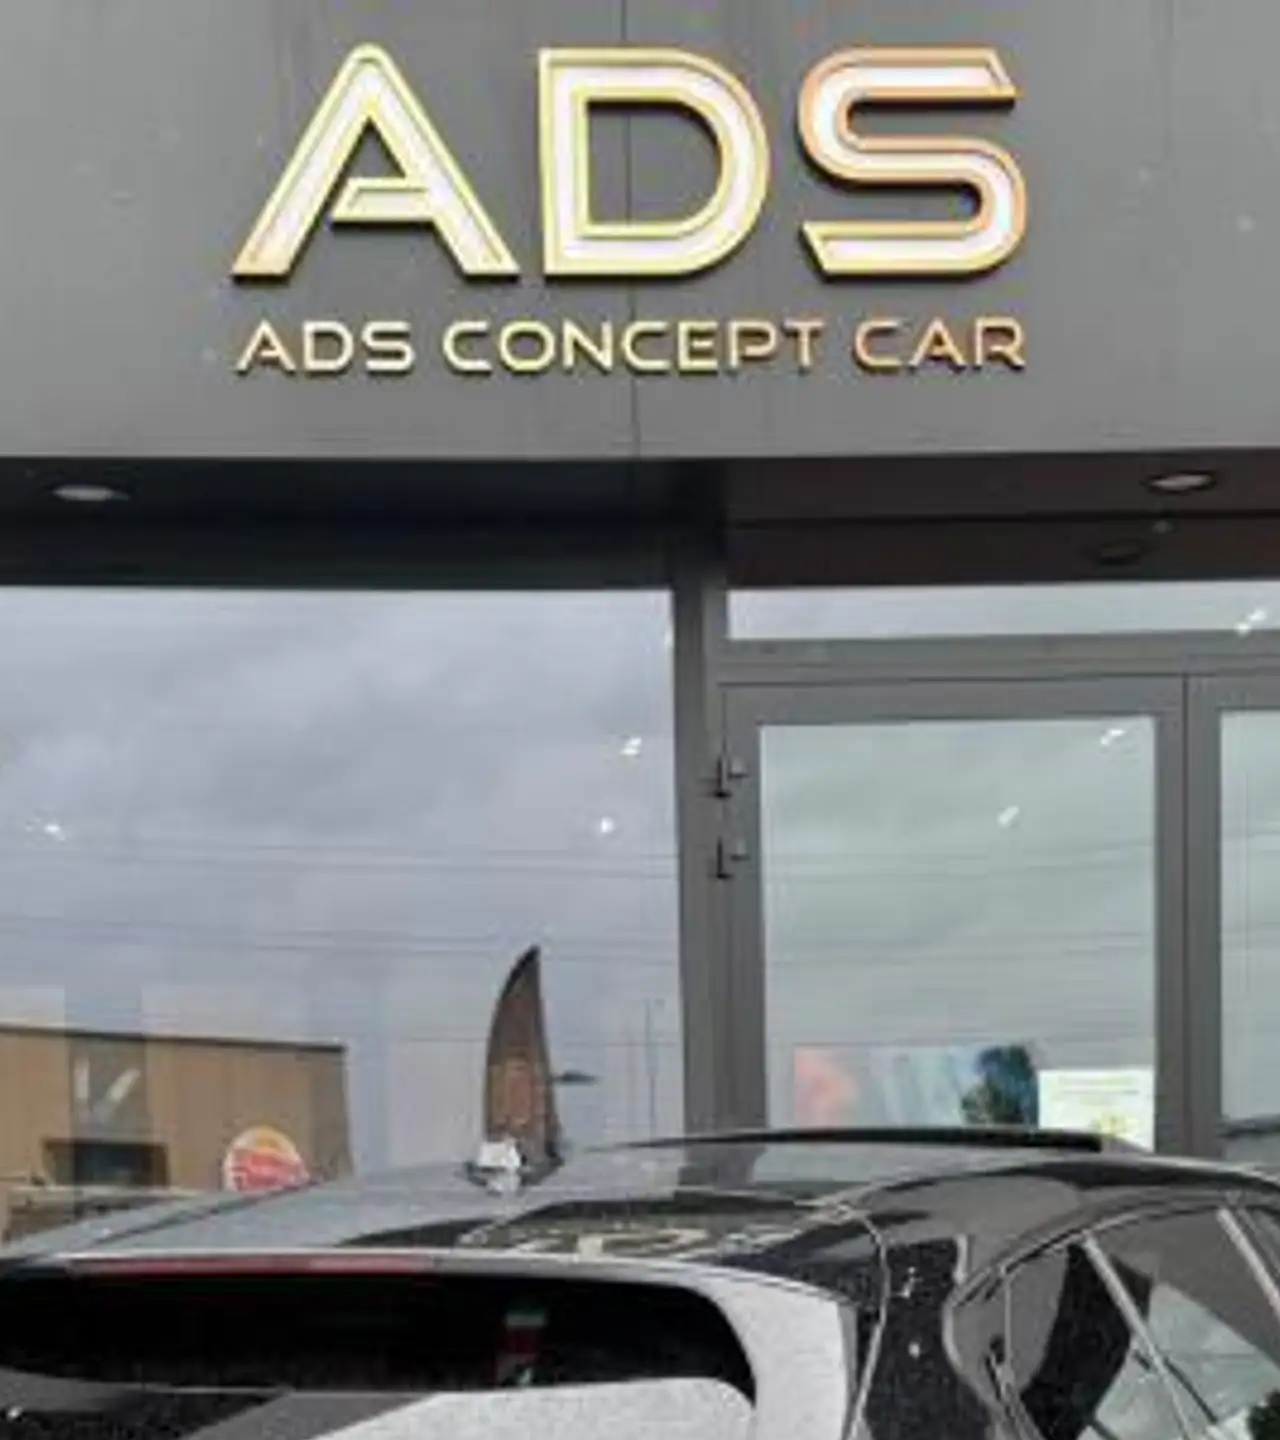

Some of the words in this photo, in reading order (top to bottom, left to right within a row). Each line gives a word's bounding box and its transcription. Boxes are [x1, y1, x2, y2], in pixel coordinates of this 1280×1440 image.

[232, 43, 1028, 280] ADS
[235, 319, 416, 375] ADS
[442, 317, 827, 374] CONCEPT
[851, 315, 1029, 371] CAR
